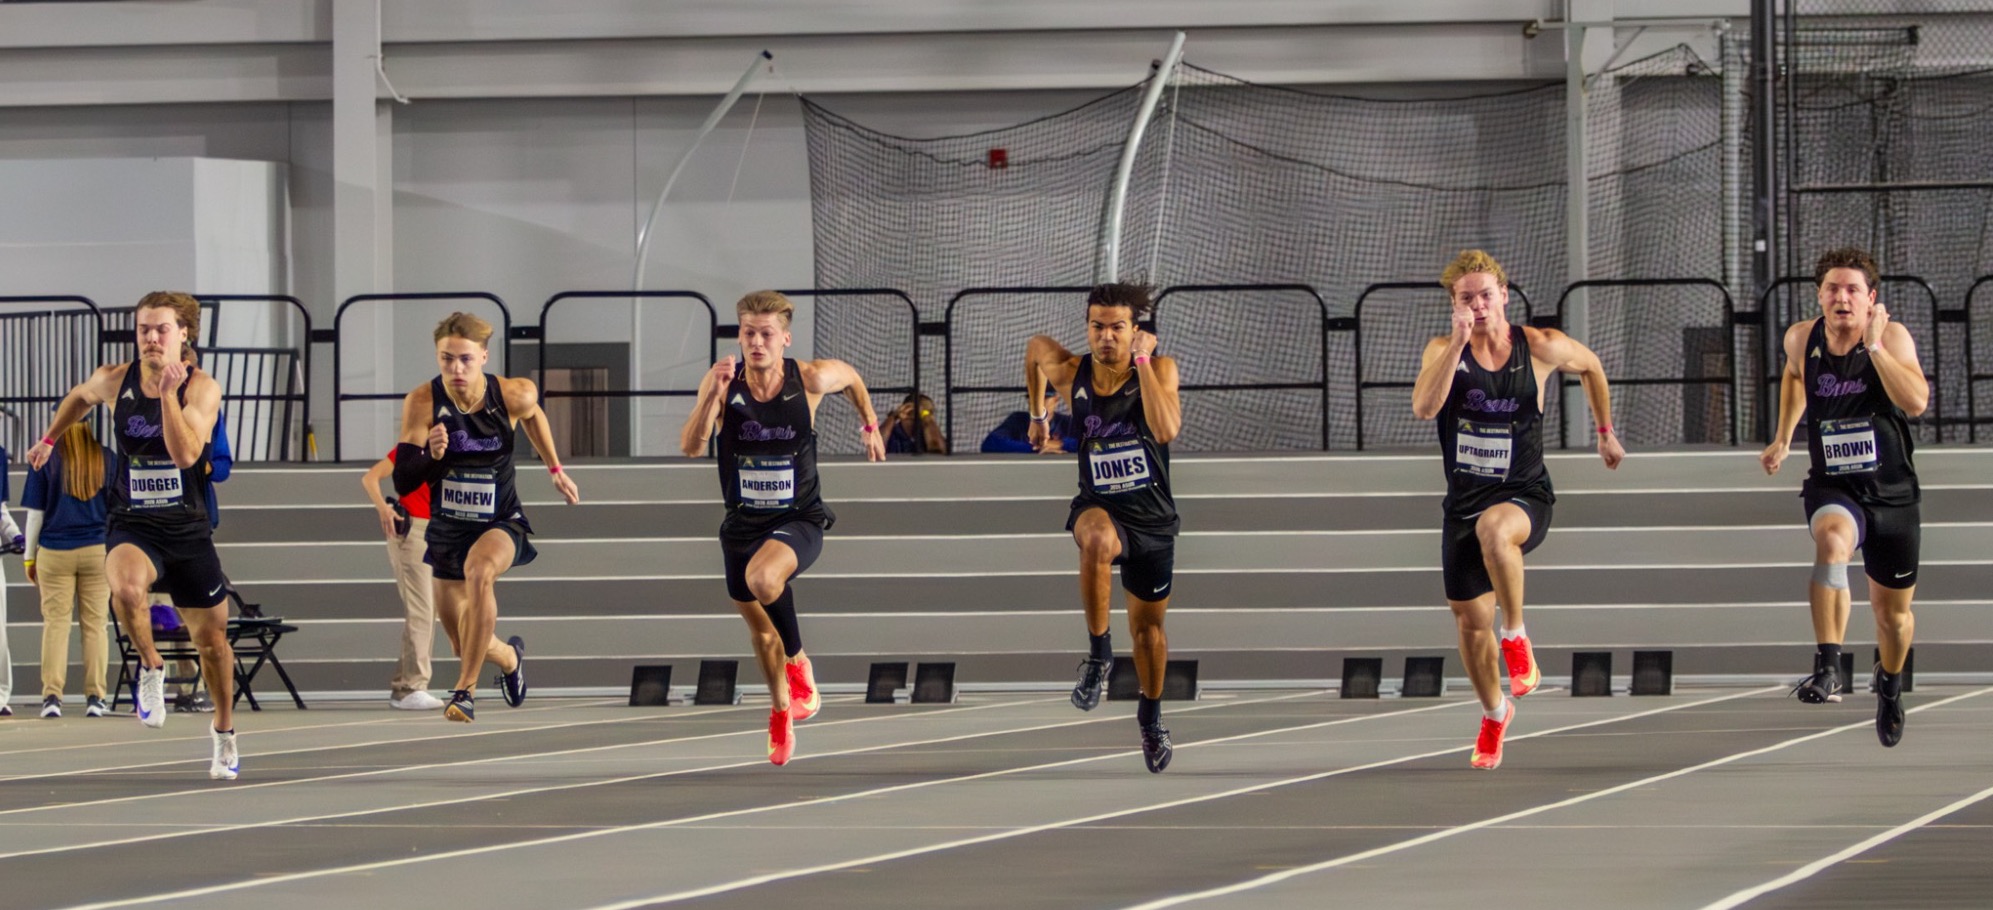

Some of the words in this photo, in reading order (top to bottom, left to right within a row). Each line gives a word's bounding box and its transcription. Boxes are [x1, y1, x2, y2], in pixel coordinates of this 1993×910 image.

[1462, 389, 1519, 412] Bears
[1459, 445, 1509, 459] UPTAGRAFFT
[1825, 440, 1874, 459] BROWN
[1094, 456, 1145, 480] JONES
[132, 478, 179, 492] DUGGER
[742, 479, 791, 491] ANDERSON
[444, 488, 493, 506] MCNEW
